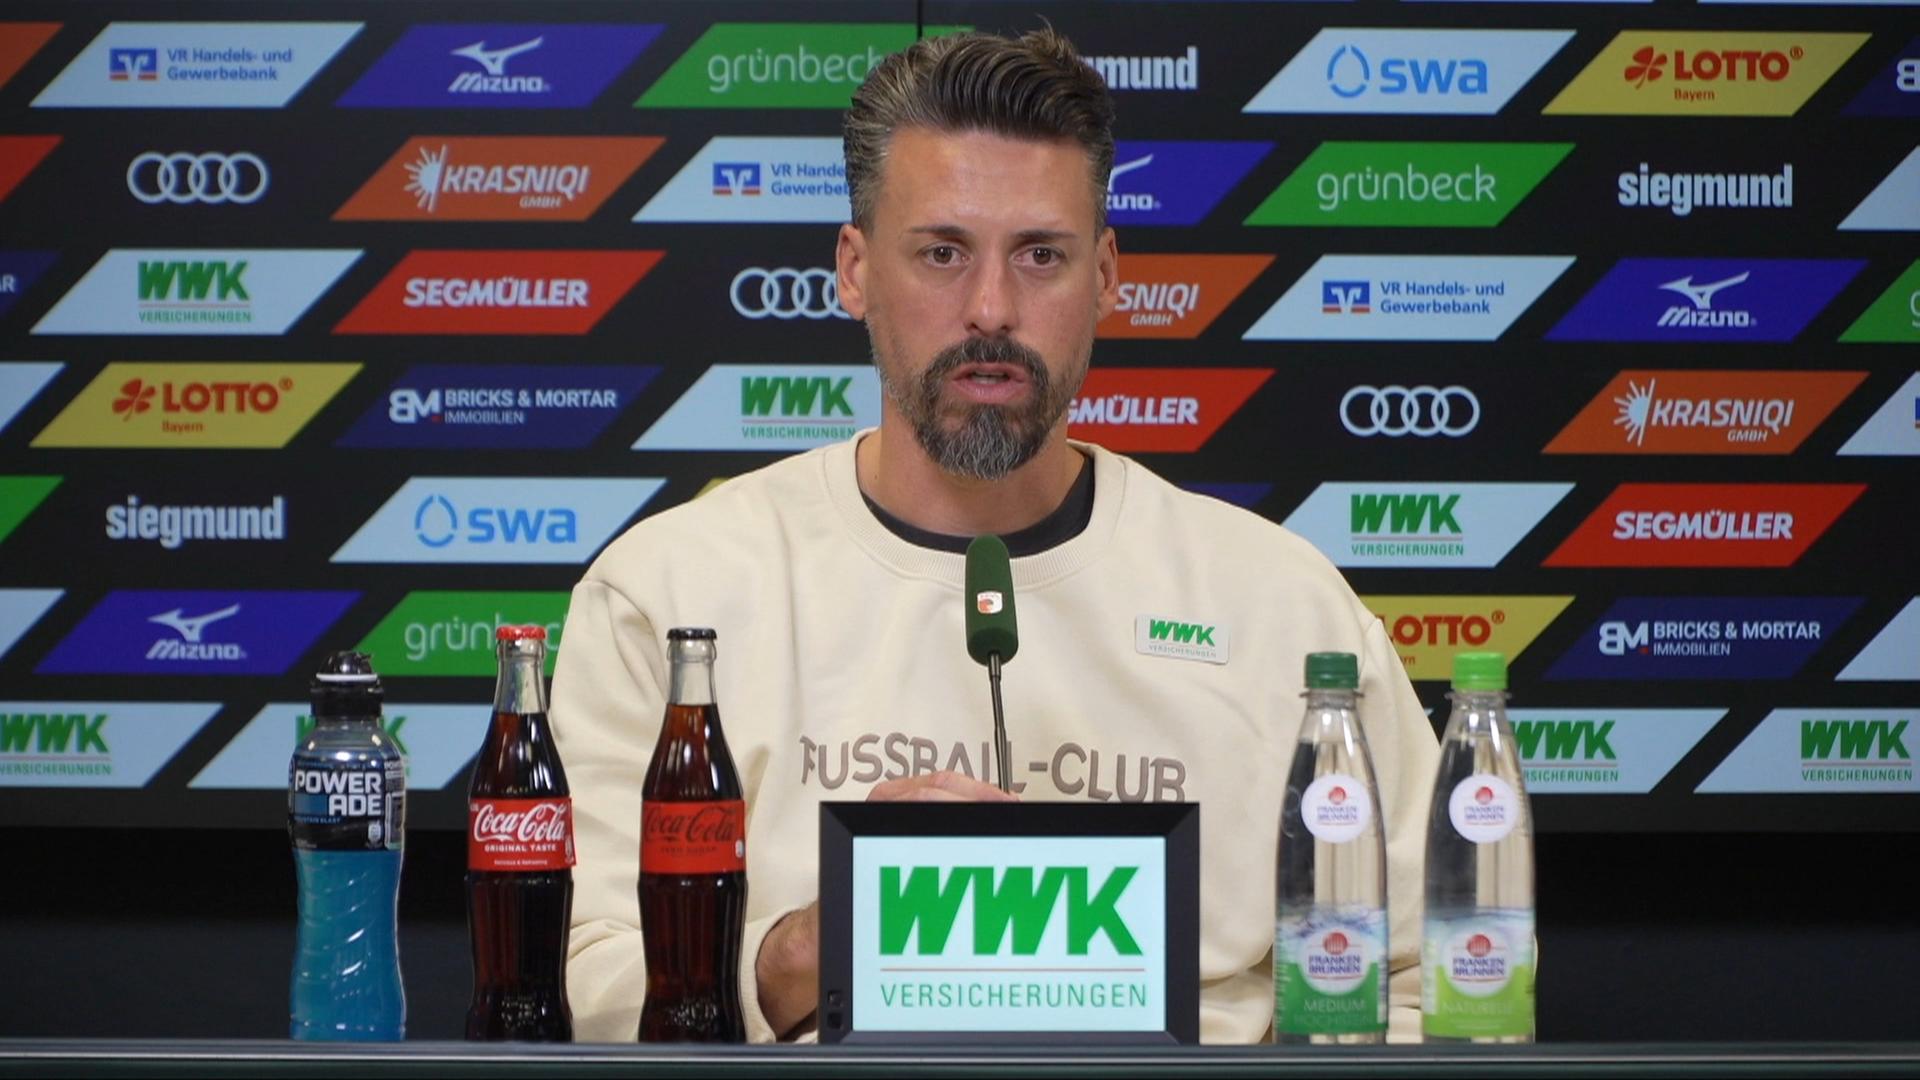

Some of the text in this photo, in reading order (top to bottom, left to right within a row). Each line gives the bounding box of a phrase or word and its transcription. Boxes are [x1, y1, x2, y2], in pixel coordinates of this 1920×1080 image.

[167, 47, 292, 63] VR Handels- und
[167, 65, 278, 81] Gewerbebank
[1380, 57, 1488, 95] swa
[1673, 88, 1715, 102] Bayern
[771, 163, 846, 177] VR Hande
[443, 165, 588, 198] KRASNIQI
[1317, 163, 1496, 211] grünbeck
[1618, 163, 1793, 215] siegmund
[519, 196, 562, 208] GMBH
[138, 261, 249, 299] WWK
[403, 276, 588, 306] SEGMÜLLER
[1380, 281, 1505, 297] VR Handels- und
[1115, 283, 1199, 318] SNIQI
[1380, 299, 1491, 315] Gewerbebank
[138, 311, 252, 323] VERSICHERUNGEN
[1130, 314, 1173, 326] GMBH
[445, 390, 617, 407] BRICKS & MORTAR
[741, 376, 853, 416] WWK
[445, 411, 525, 424] IMMOBILIEN
[1067, 395, 1199, 424] MÜLLER
[1652, 399, 1793, 434] KRASNIQI
[162, 421, 204, 434] Bayern
[742, 426, 856, 439] VERSICHERUNGEN
[1727, 430, 1768, 442] GMBH
[105, 496, 285, 548] siegmund
[1350, 494, 1462, 533] WWK
[468, 506, 577, 543] swa
[1612, 509, 1793, 540] SEGMÜLLER
[1351, 543, 1464, 556] VERSICHERUNGEN
[1149, 619, 1216, 647] WWK
[1654, 621, 1821, 639] BRICKS & MORTAR
[1654, 643, 1730, 655] IMMOBILIEN
[0, 714, 108, 752] WWK
[1801, 720, 1910, 759] WWK
[295, 770, 382, 794] POWER
[1801, 769, 1912, 782] VERSICHERUNGEN
[329, 795, 382, 816] ADE
[474, 803, 567, 842] Coca-Cola
[485, 843, 556, 852] ORIGINAL TASTE
[879, 866, 1143, 955] WWK
[1309, 955, 1360, 964] FRANKEN
[1453, 958, 1504, 967] FRANKEN
[1309, 964, 1360, 974] BRUNNEN
[1453, 967, 1504, 977] BRUNNEN
[880, 983, 1147, 1007] VERSICHERUNGEN
[1304, 998, 1365, 1012] MEDIUM
